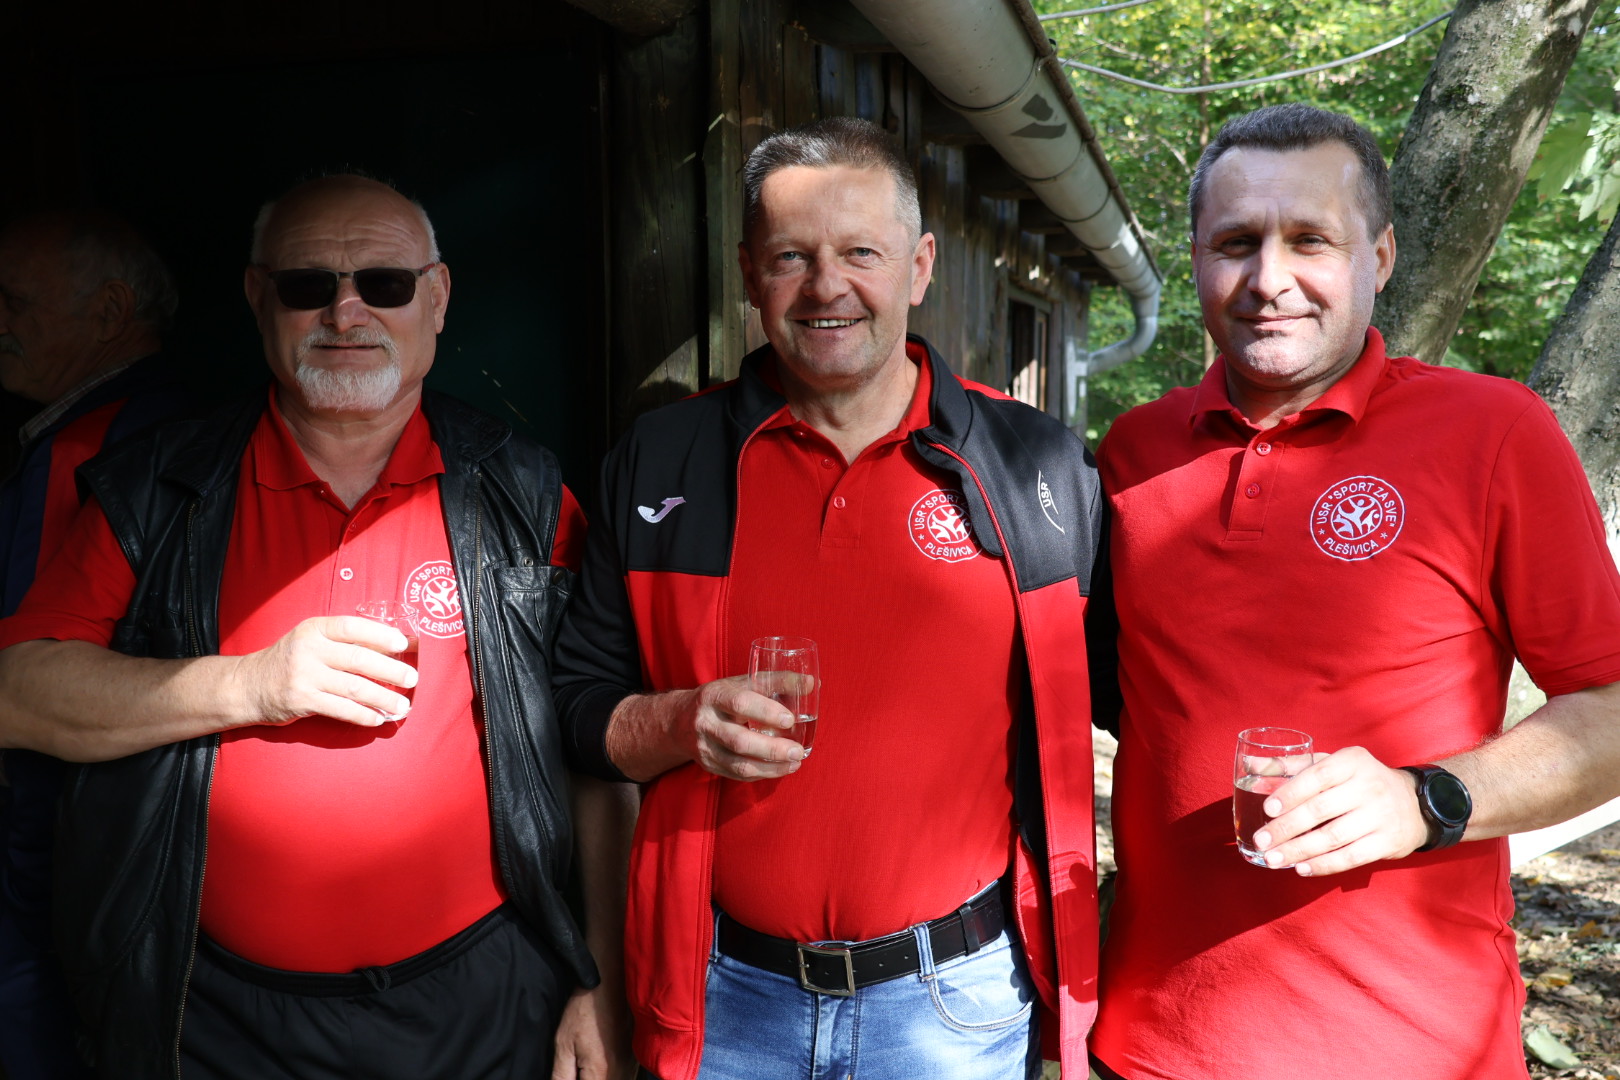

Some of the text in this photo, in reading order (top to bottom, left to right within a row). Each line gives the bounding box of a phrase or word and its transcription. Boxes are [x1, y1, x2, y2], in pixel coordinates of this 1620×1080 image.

[1041, 482, 1051, 508] USR
[1316, 502, 1333, 524] USR
[1373, 486, 1389, 501] ZA
[914, 510, 927, 530] USR
[925, 542, 973, 557] PLEŠIVICA
[1323, 537, 1379, 555] PLEŠIVICA
